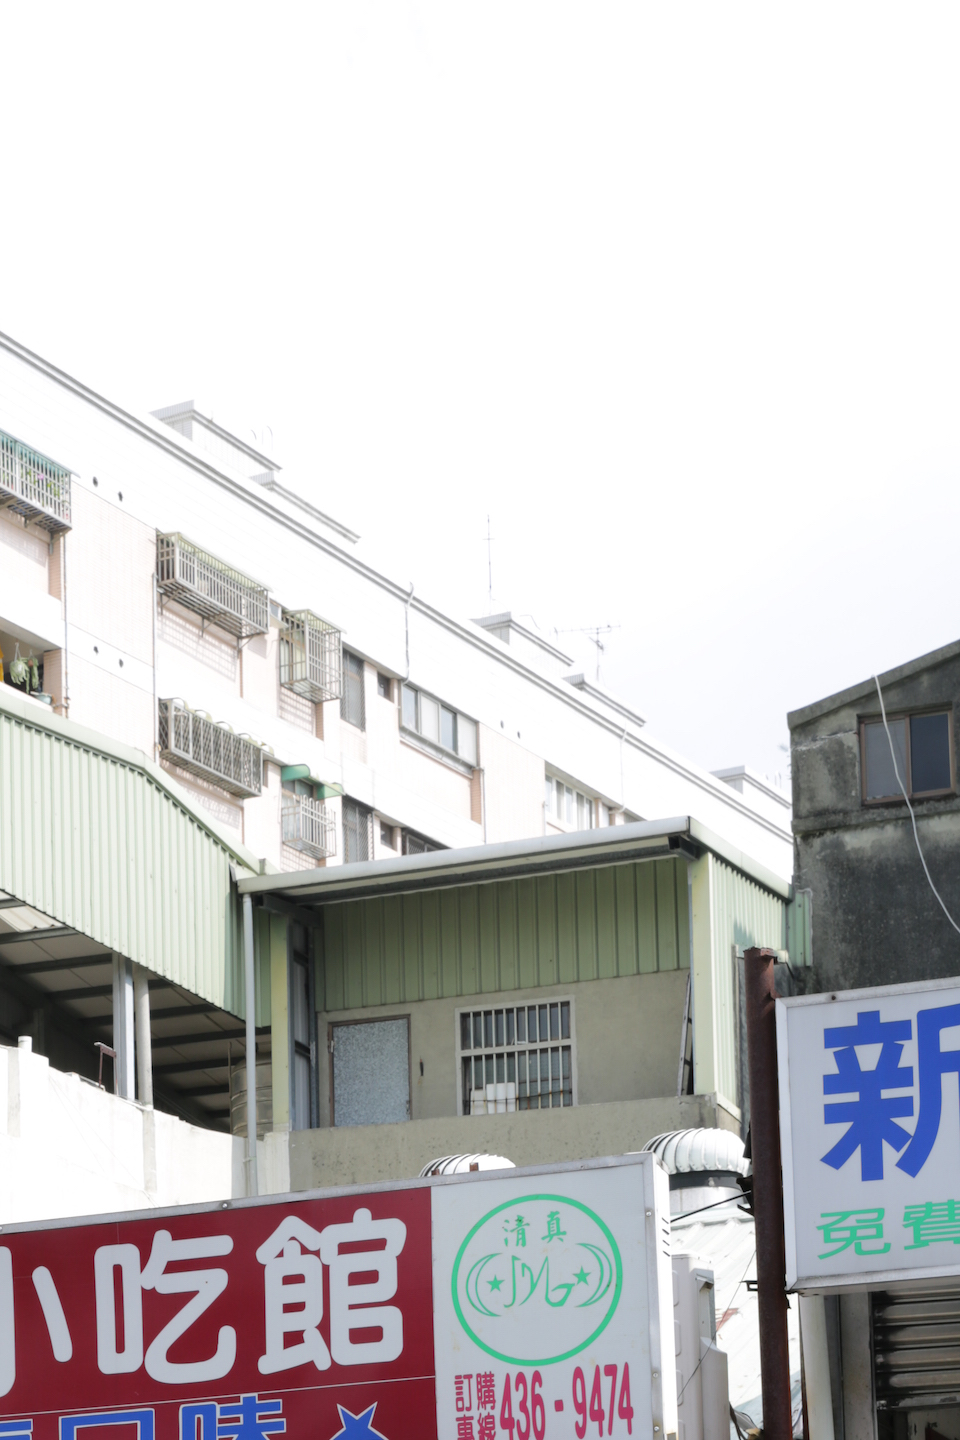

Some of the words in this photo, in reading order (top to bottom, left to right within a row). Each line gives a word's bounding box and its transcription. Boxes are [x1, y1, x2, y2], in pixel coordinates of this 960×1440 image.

[503, 1210, 567, 1248] 清真
[816, 1199, 960, 1259] 免費
[454, 1370, 497, 1413] 訂購
